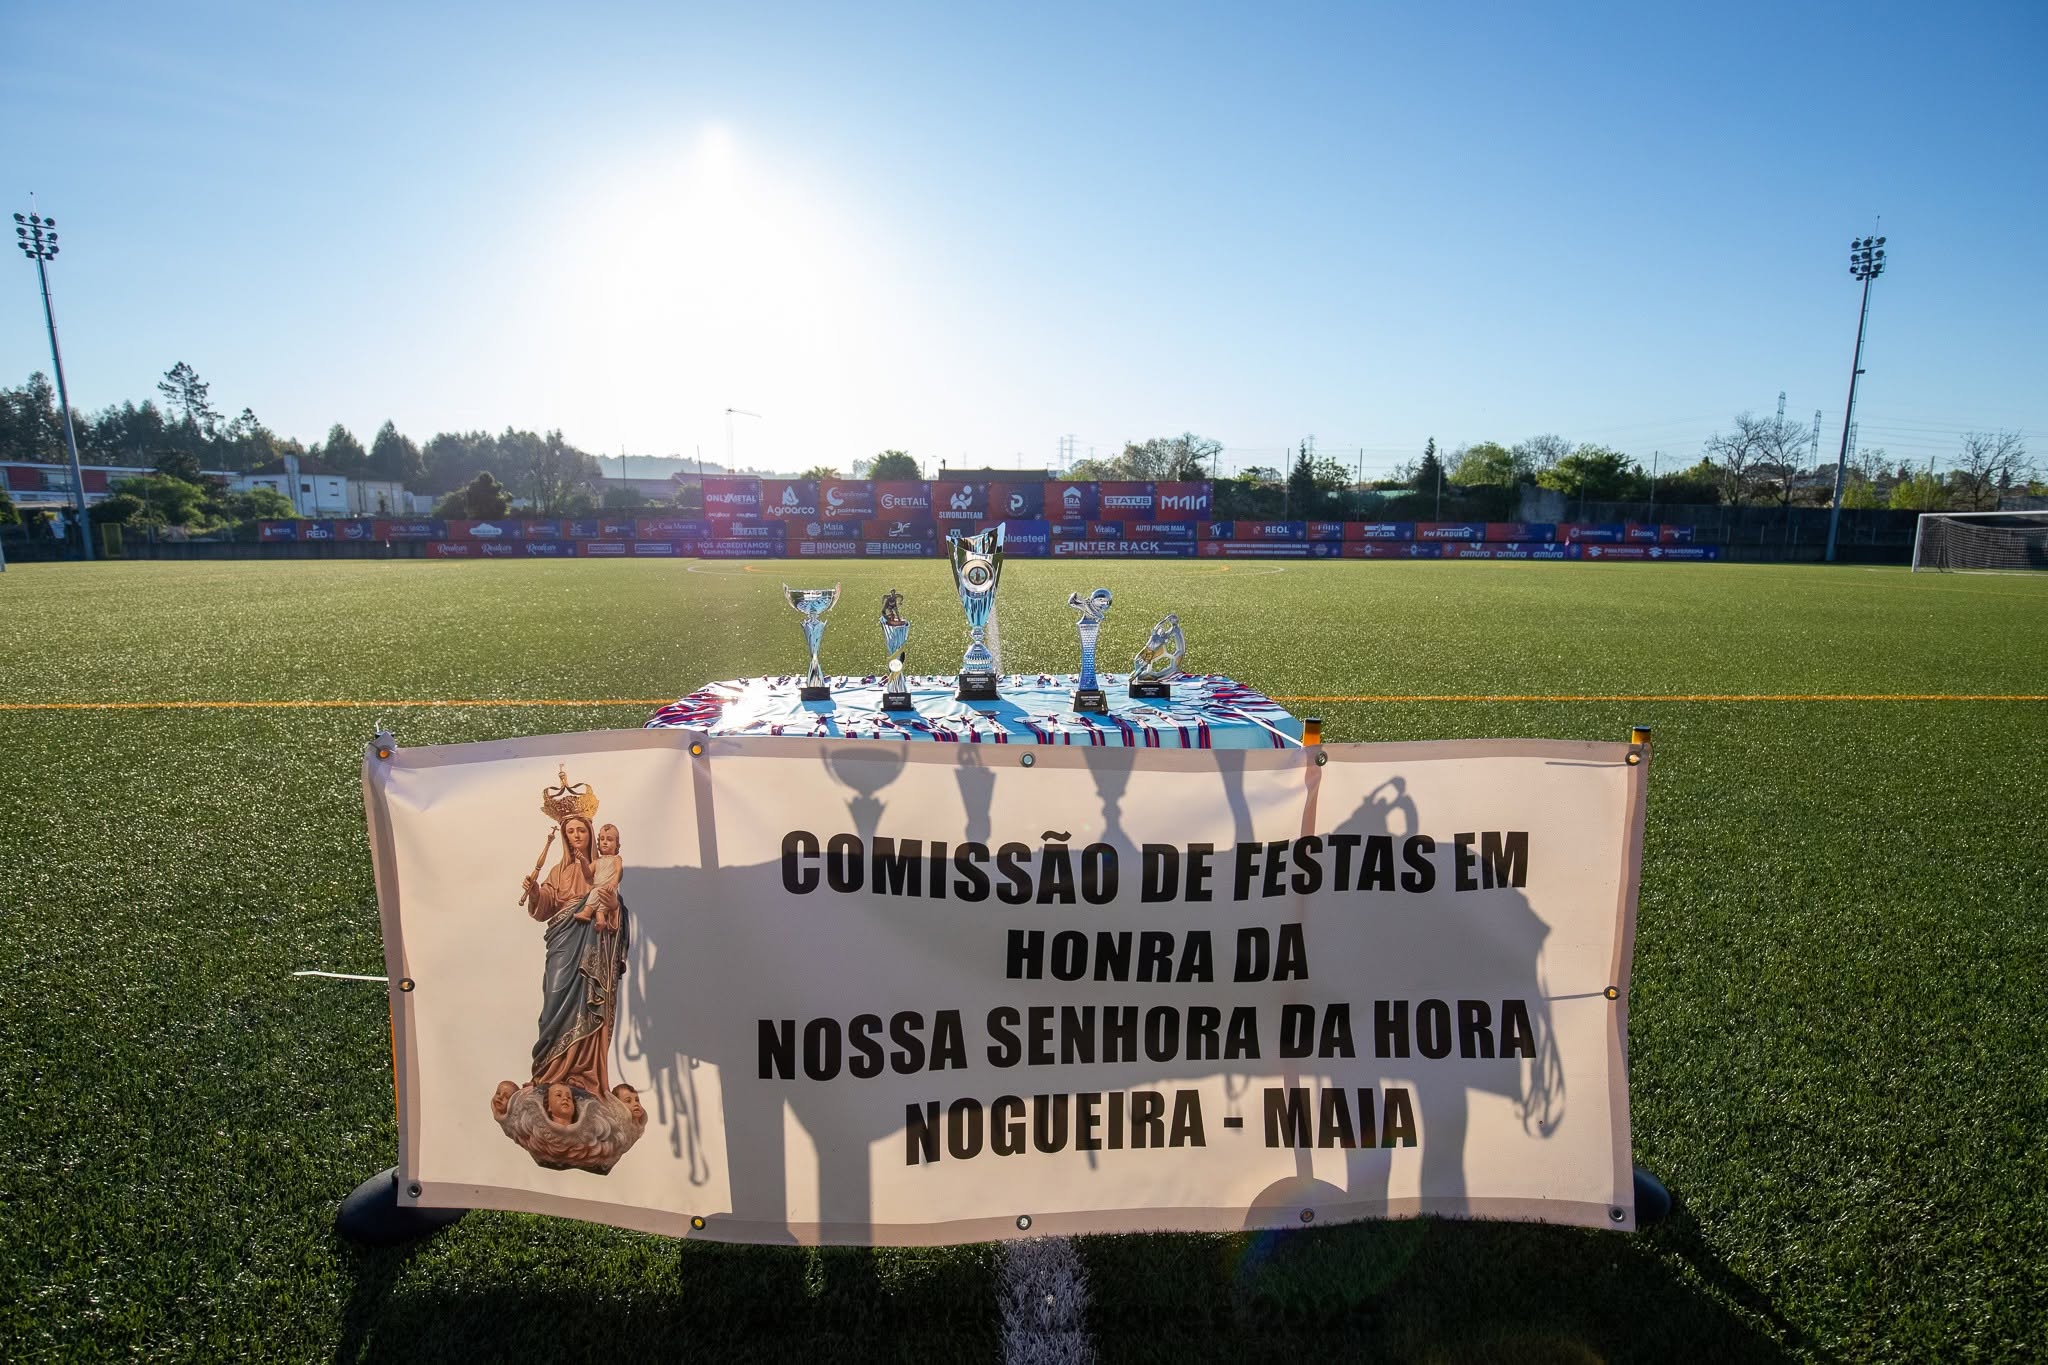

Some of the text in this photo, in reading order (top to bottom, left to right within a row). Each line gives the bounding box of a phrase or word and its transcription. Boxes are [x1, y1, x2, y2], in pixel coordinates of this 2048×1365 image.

[894, 497, 928, 506] RETAIL
[1105, 497, 1150, 505] STATUS
[767, 505, 815, 516] Agroarco
[1094, 524, 1117, 533] Vitalis
[1265, 526, 1290, 534] REOL
[306, 531, 328, 539] RED
[1075, 542, 1116, 550] INTER
[1120, 542, 1160, 550] RACK
[782, 831, 1528, 904] COMISSÃO DE FESTAS EM
[1007, 923, 1309, 983] HONRA DA
[758, 999, 1537, 1082] NOSSA SENHORA DA HORA
[906, 1089, 1207, 1166] NOGUEIRA
[1264, 1088, 1418, 1149] MAIA
